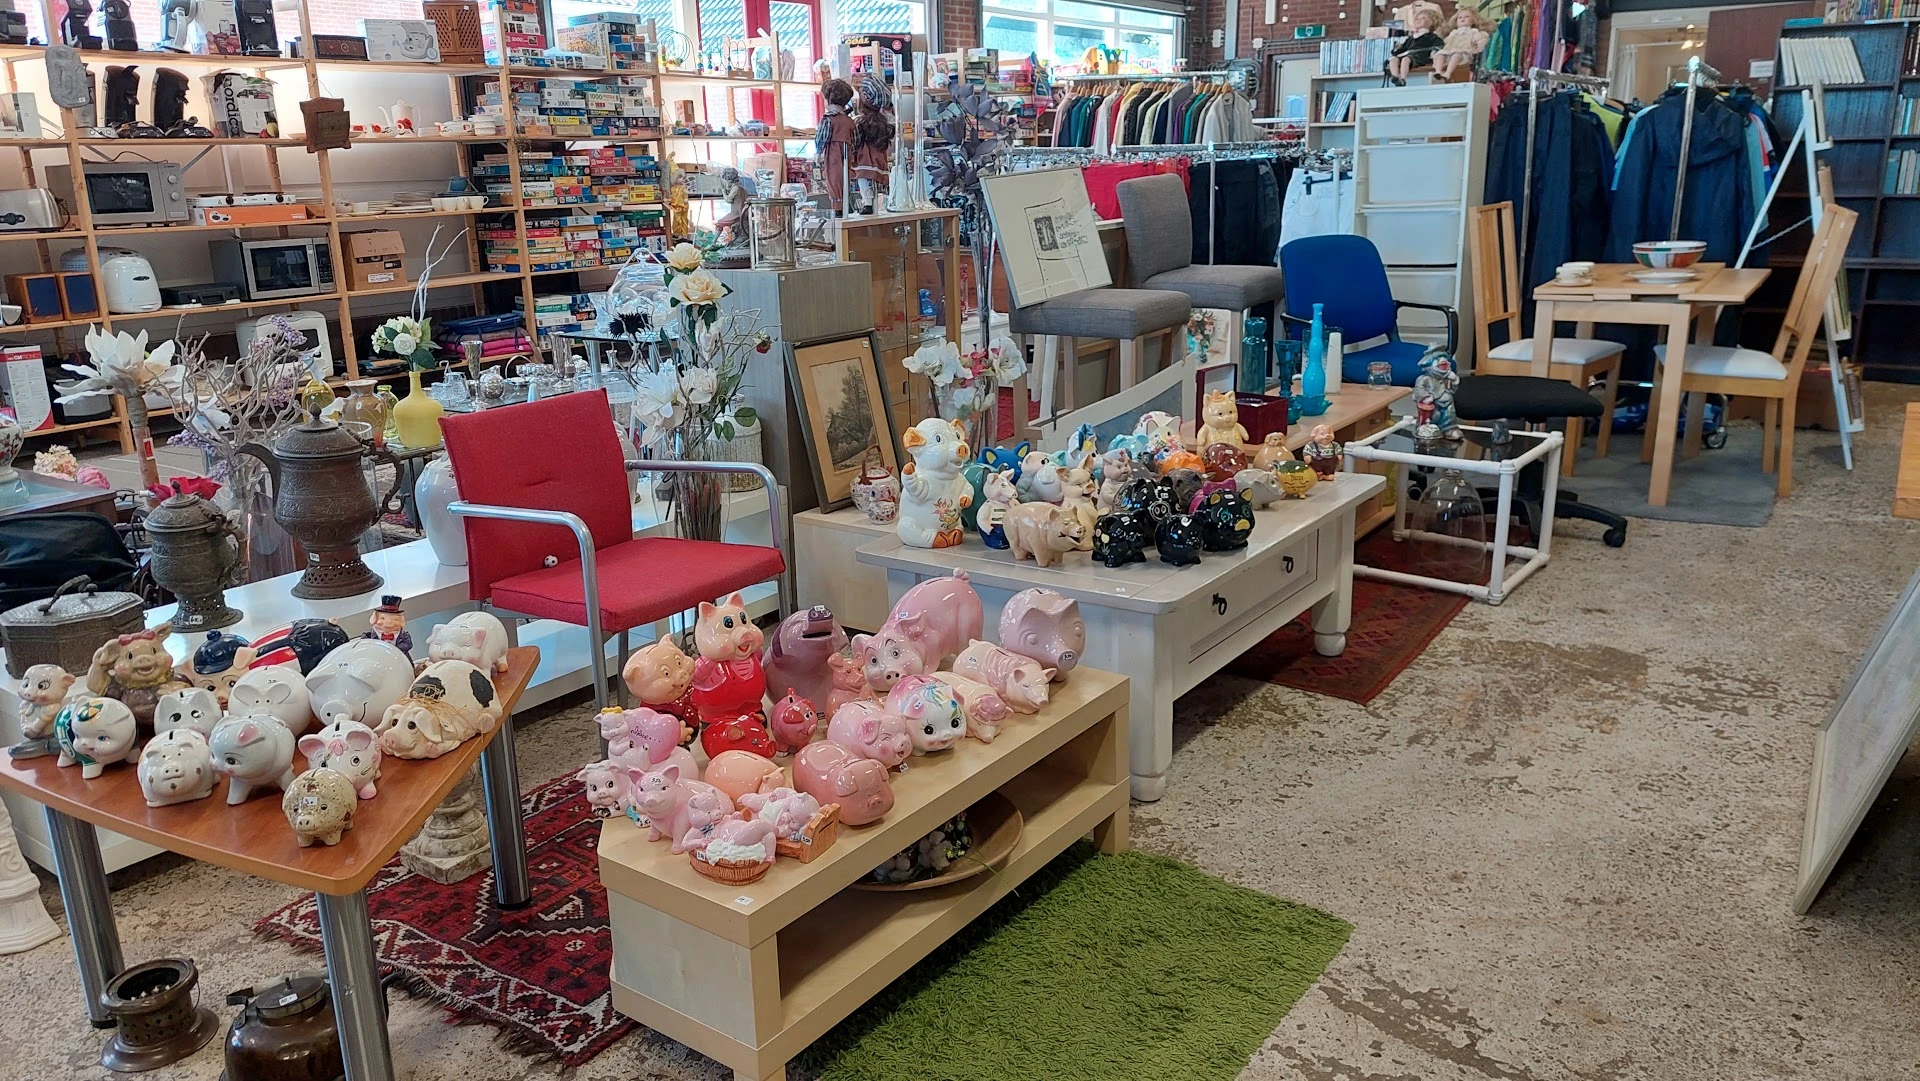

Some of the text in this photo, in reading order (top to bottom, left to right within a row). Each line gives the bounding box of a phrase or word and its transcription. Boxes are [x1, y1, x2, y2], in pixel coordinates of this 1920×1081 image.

[845, 37, 870, 45] GOAL
[223, 76, 240, 137] nordica
[582, 259, 600, 267] PUZZLE
